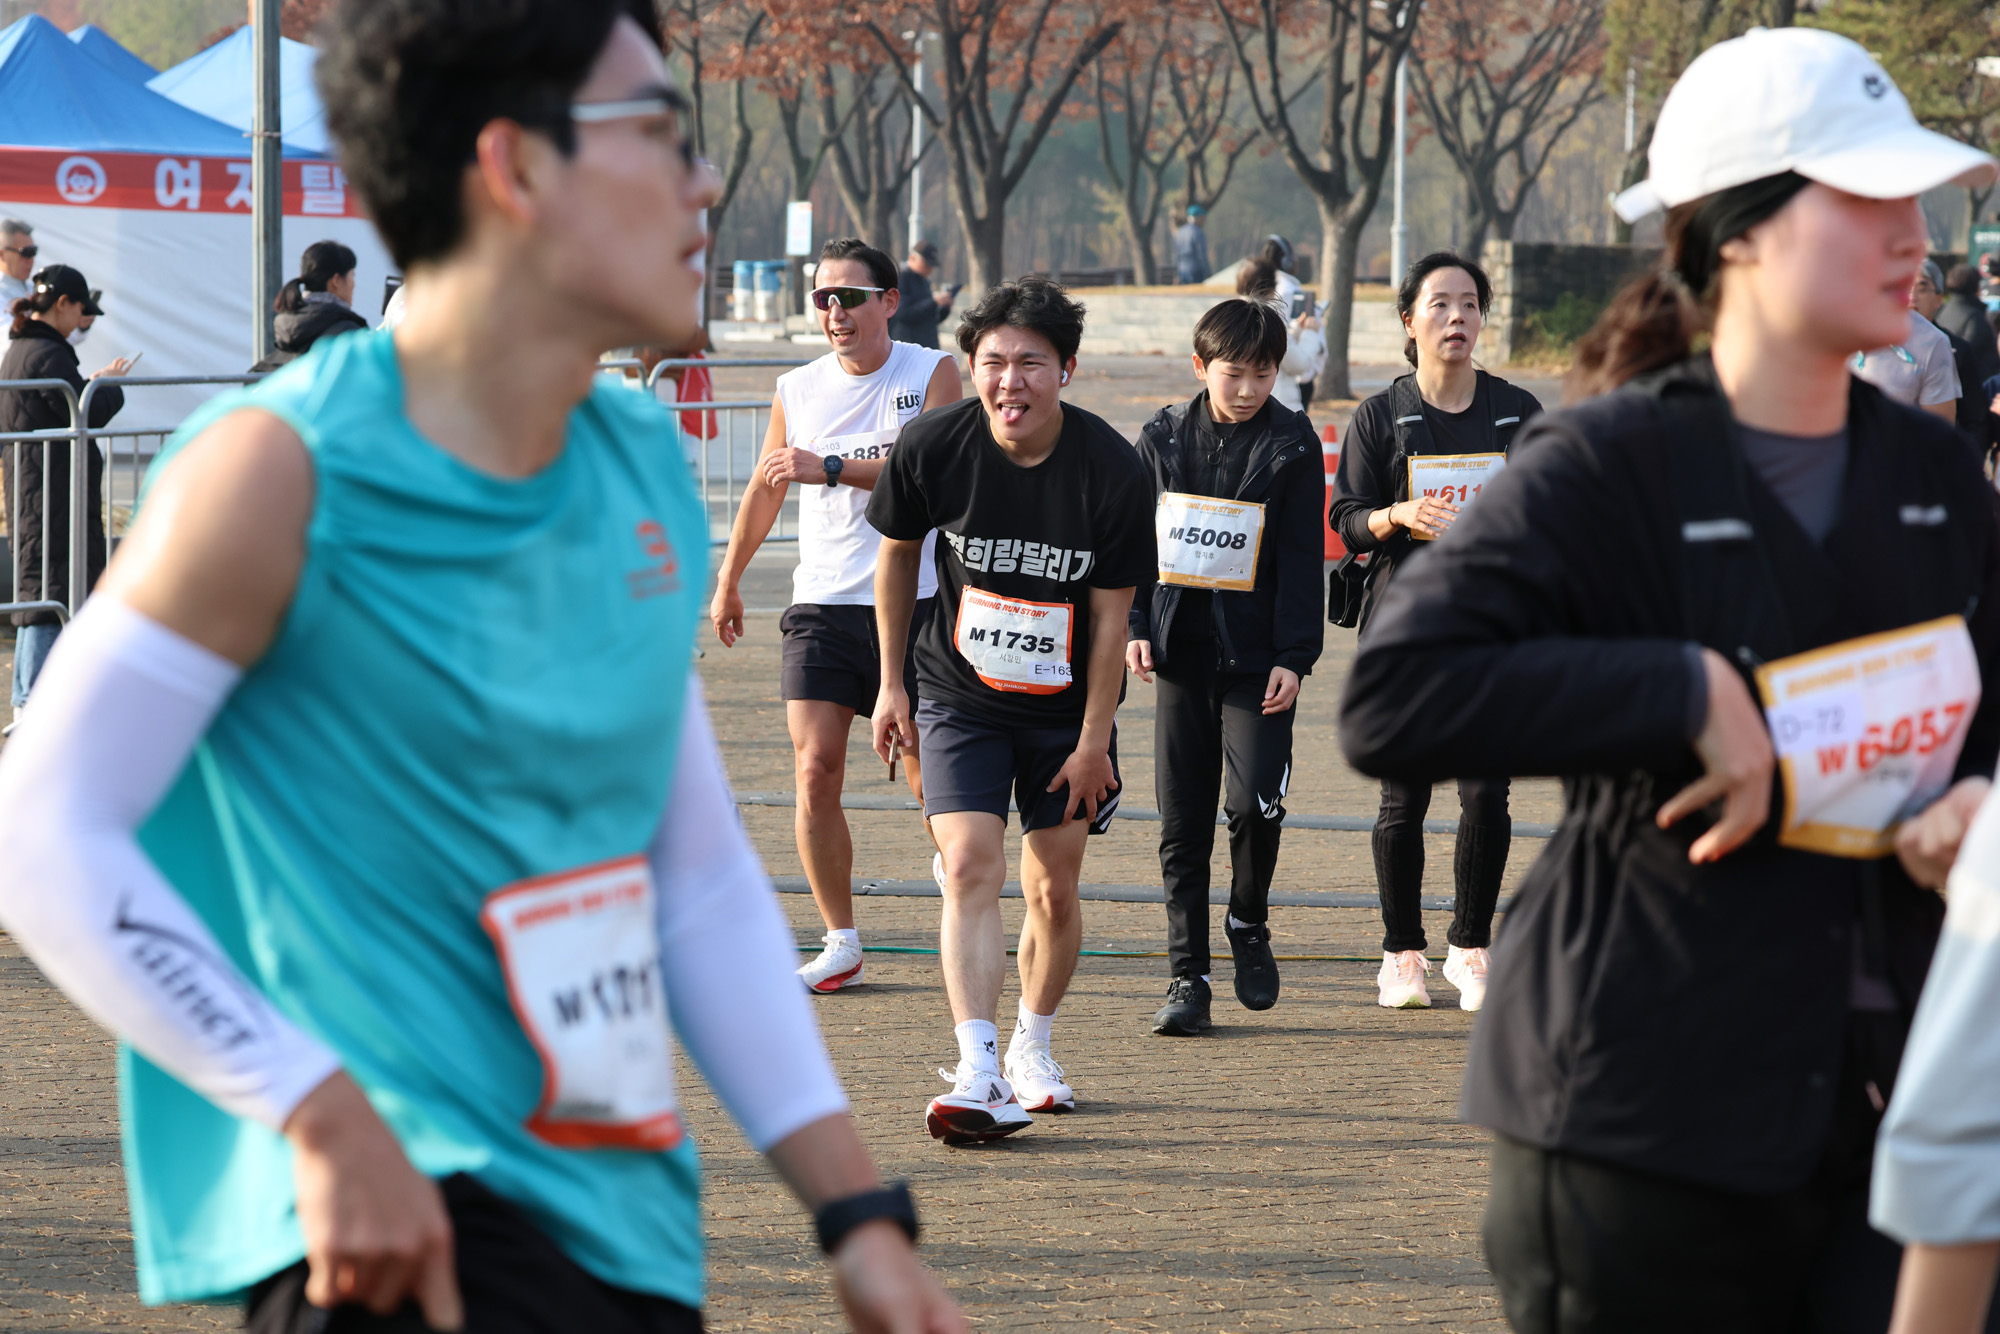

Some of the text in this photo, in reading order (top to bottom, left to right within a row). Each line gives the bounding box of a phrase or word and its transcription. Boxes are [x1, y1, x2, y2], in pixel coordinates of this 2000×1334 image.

[1416, 462, 1450, 470] BURNING
[1450, 461, 1468, 469] RUN
[1467, 460, 1492, 469] STORY
[1200, 503, 1218, 512] RUN
[1218, 505, 1245, 515] STORY
[1168, 526, 1248, 550] M5008
[967, 596, 1002, 610] BURNING
[1002, 604, 1021, 614] RUN
[1020, 608, 1050, 619] STORY
[969, 626, 1055, 654] M1735
